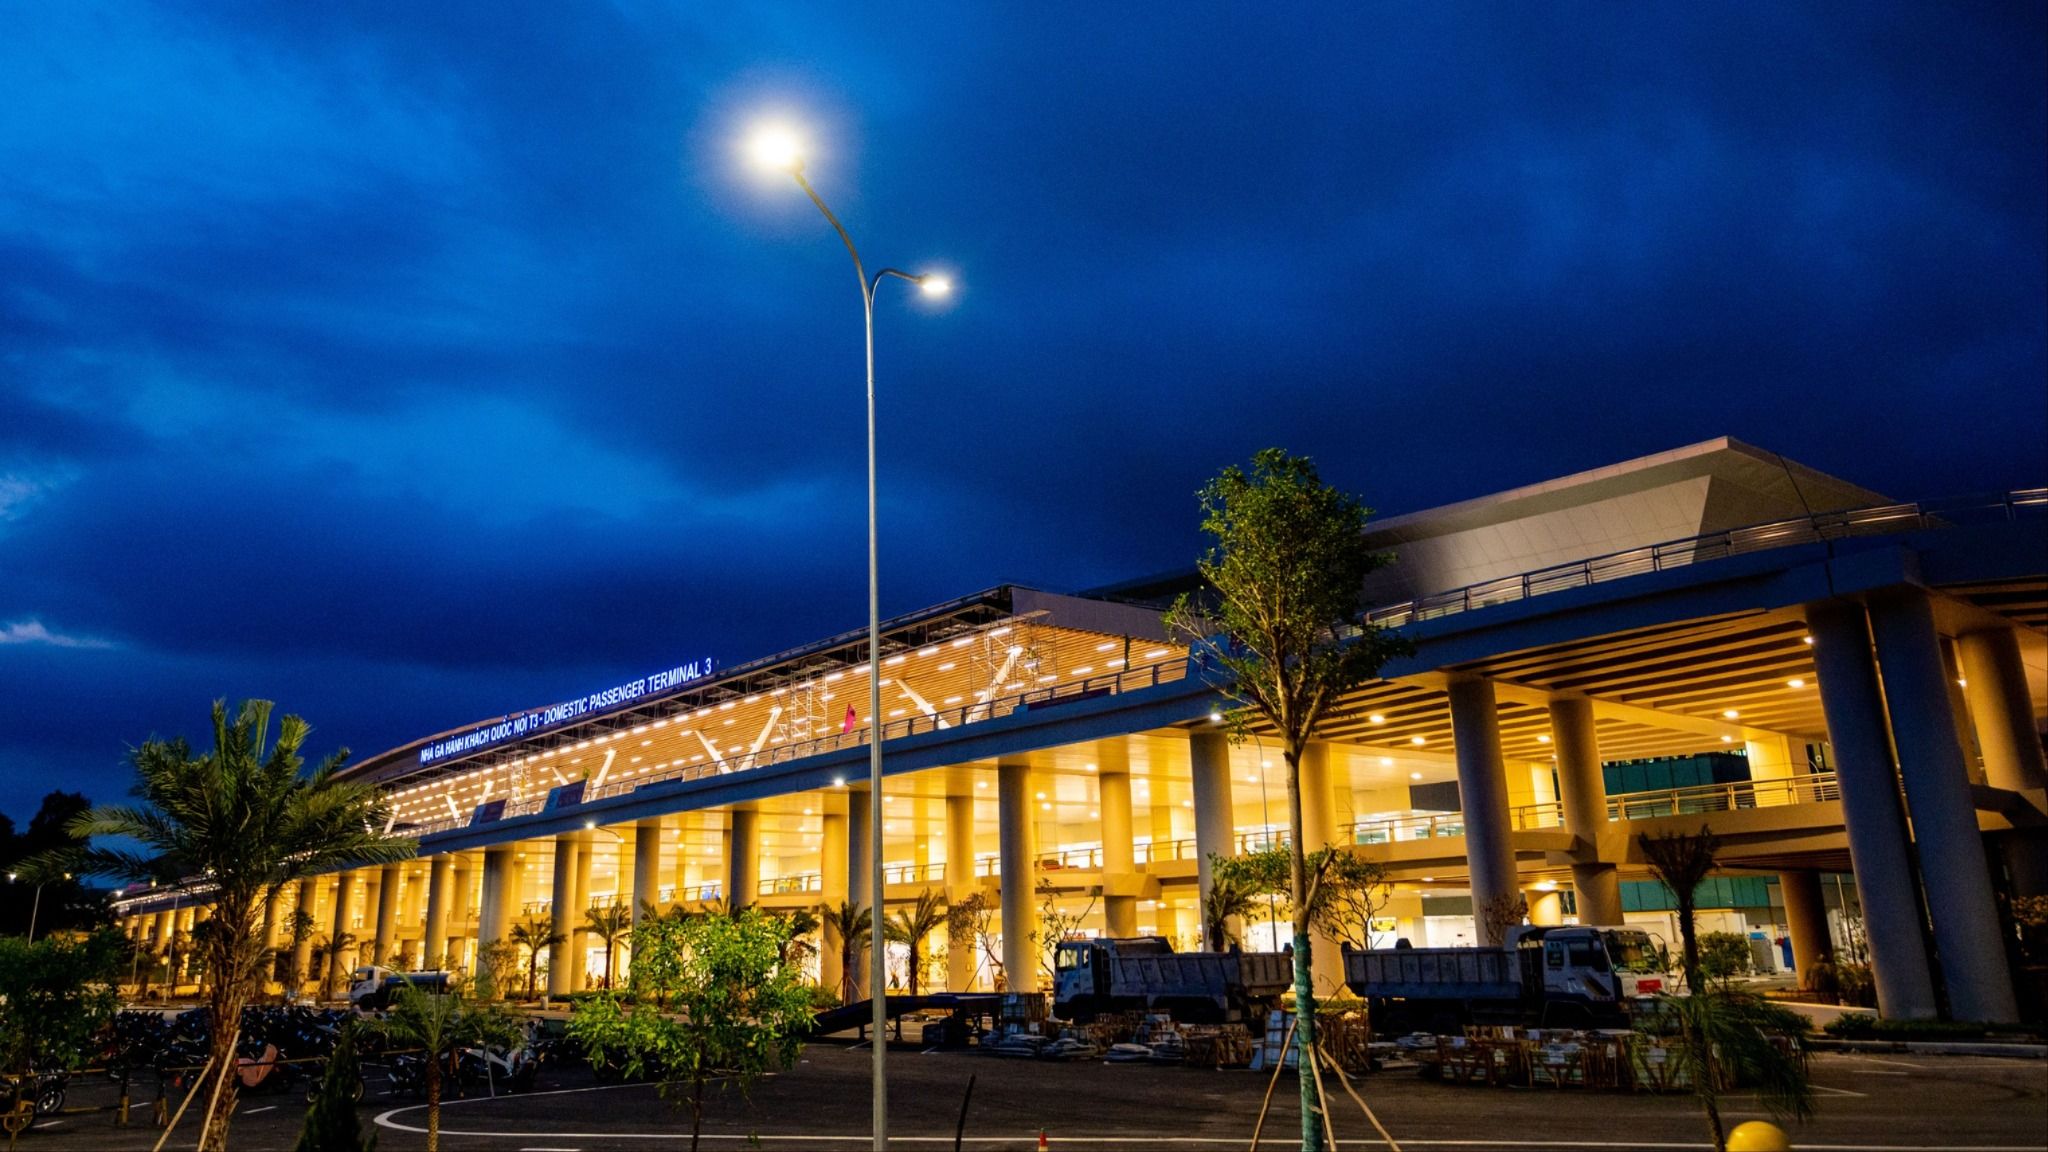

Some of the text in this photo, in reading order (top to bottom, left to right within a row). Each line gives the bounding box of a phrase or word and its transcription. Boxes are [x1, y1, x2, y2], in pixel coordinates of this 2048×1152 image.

[435, 746, 444, 759] GA
[445, 736, 464, 755] HÀNH
[464, 727, 489, 749] KHÁCH
[490, 715, 512, 741] QUỐC
[513, 713, 528, 736] NỘI
[529, 713, 539, 729] T3
[544, 698, 588, 725] DOMESTIC
[589, 679, 646, 710] PASSENGER
[648, 661, 701, 693] TERMINAL
[704, 657, 712, 675] 3
